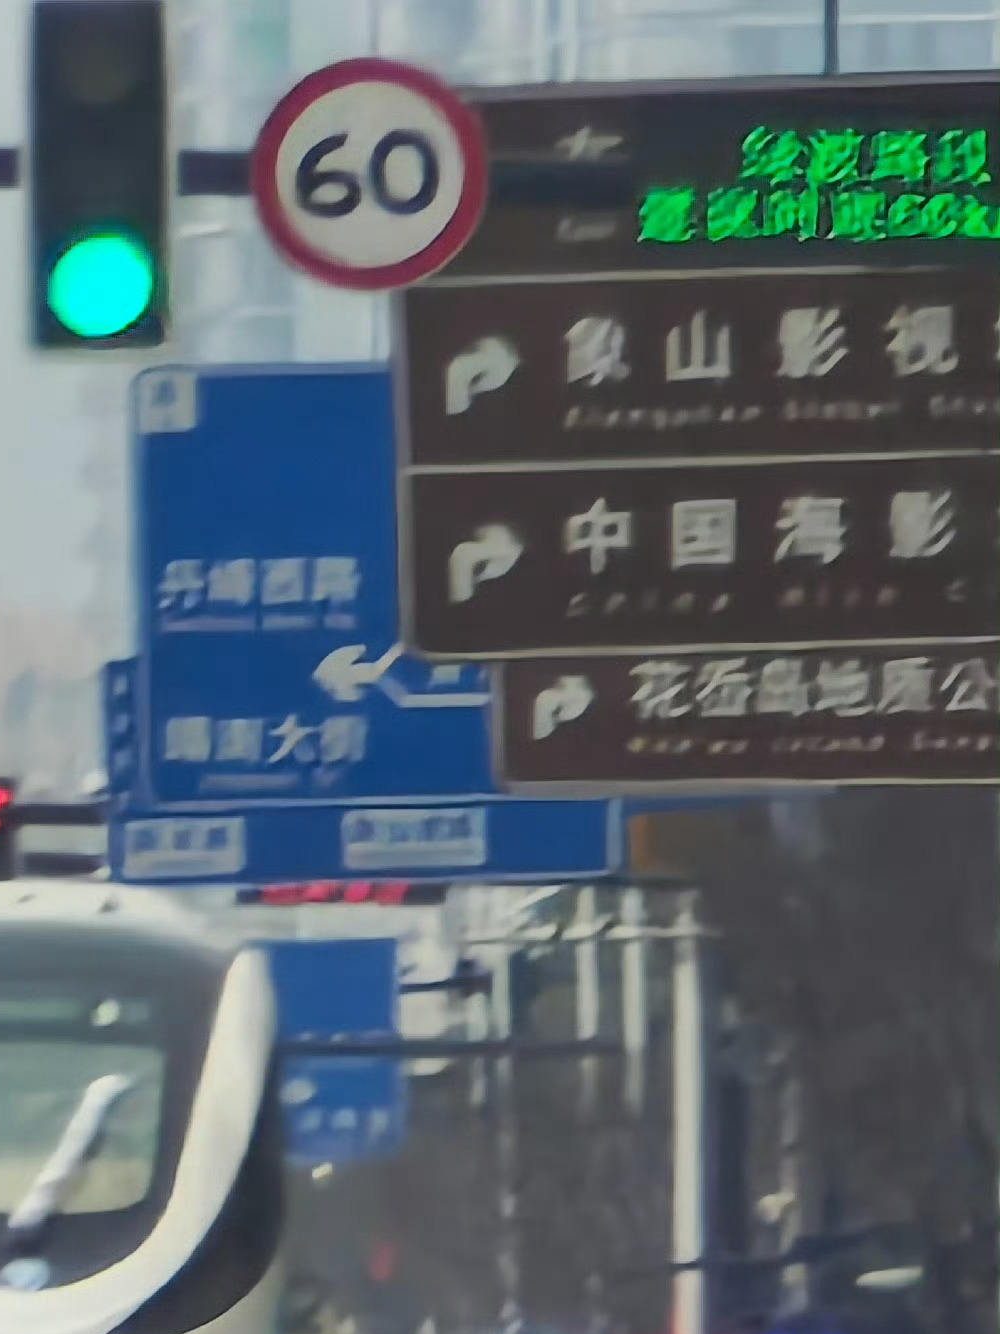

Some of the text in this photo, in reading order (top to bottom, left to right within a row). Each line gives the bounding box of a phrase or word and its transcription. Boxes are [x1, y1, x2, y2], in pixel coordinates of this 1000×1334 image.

[297, 129, 440, 218] 60
[564, 305, 1000, 386] 象山影视
